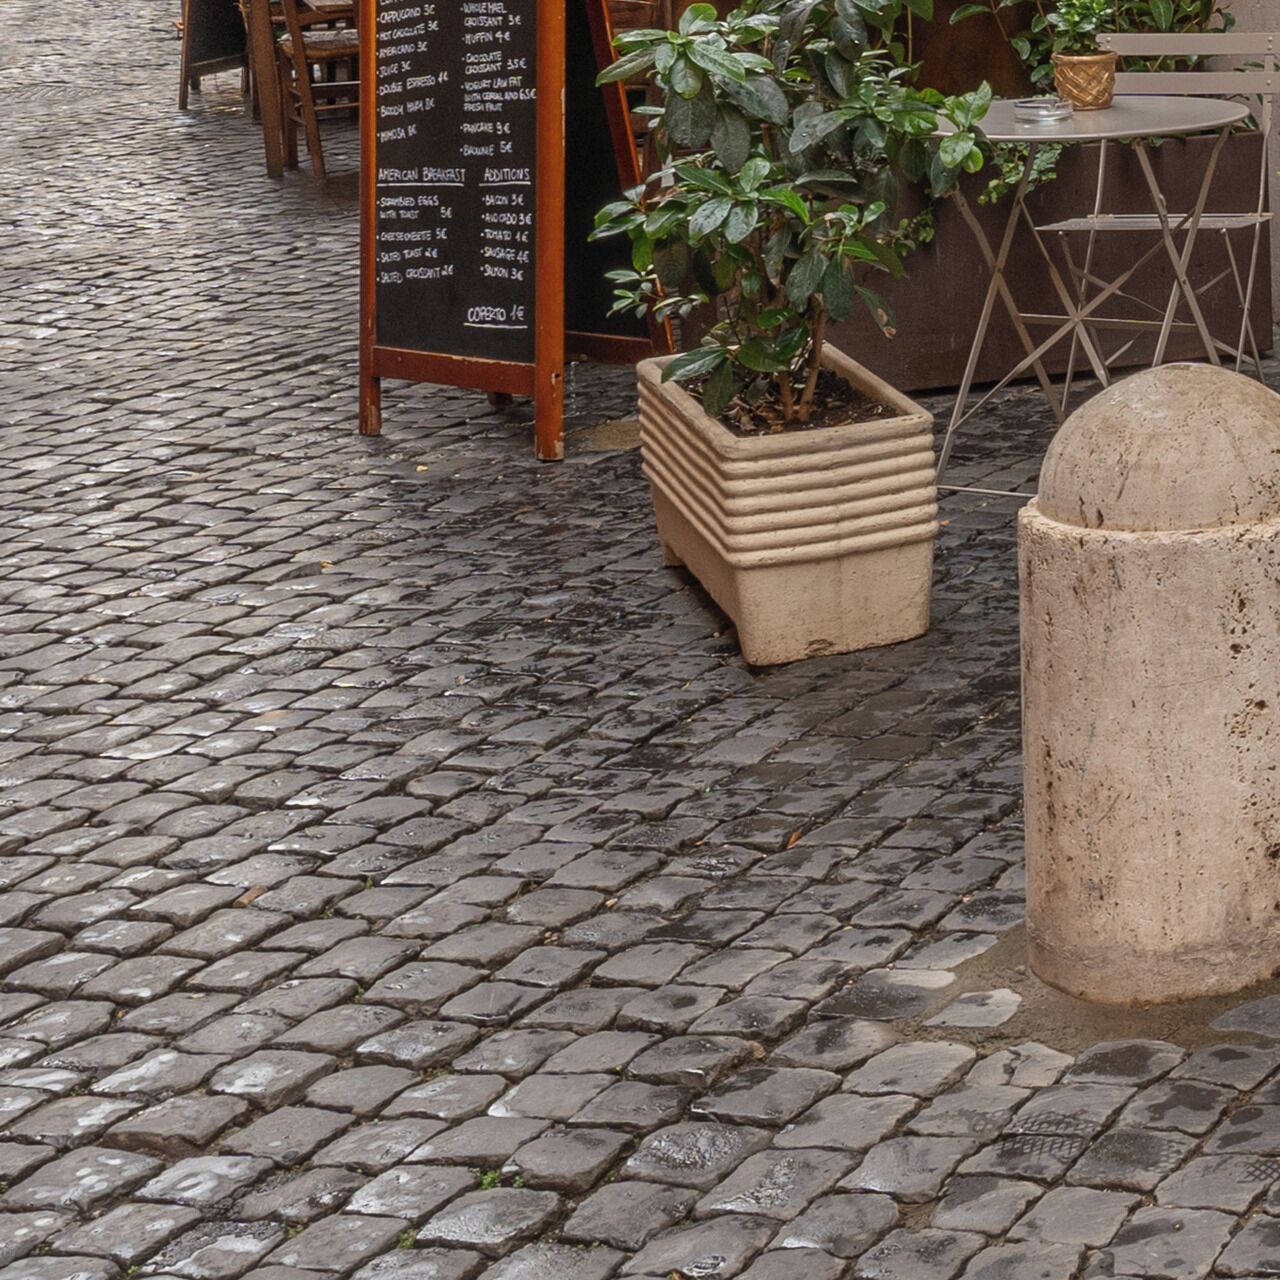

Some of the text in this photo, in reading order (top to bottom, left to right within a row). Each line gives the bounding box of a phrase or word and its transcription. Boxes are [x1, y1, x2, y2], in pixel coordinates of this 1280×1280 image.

[465, 31, 493, 45] MUFFIN
[378, 167, 466, 182] AMERICAN BREAKFAST
[484, 168, 530, 181] ADDITIONS
[418, 195, 439, 206] EGGS
[485, 195, 509, 206] BACON
[485, 229, 512, 241] TOMATO
[467, 306, 506, 321] COPERTO
